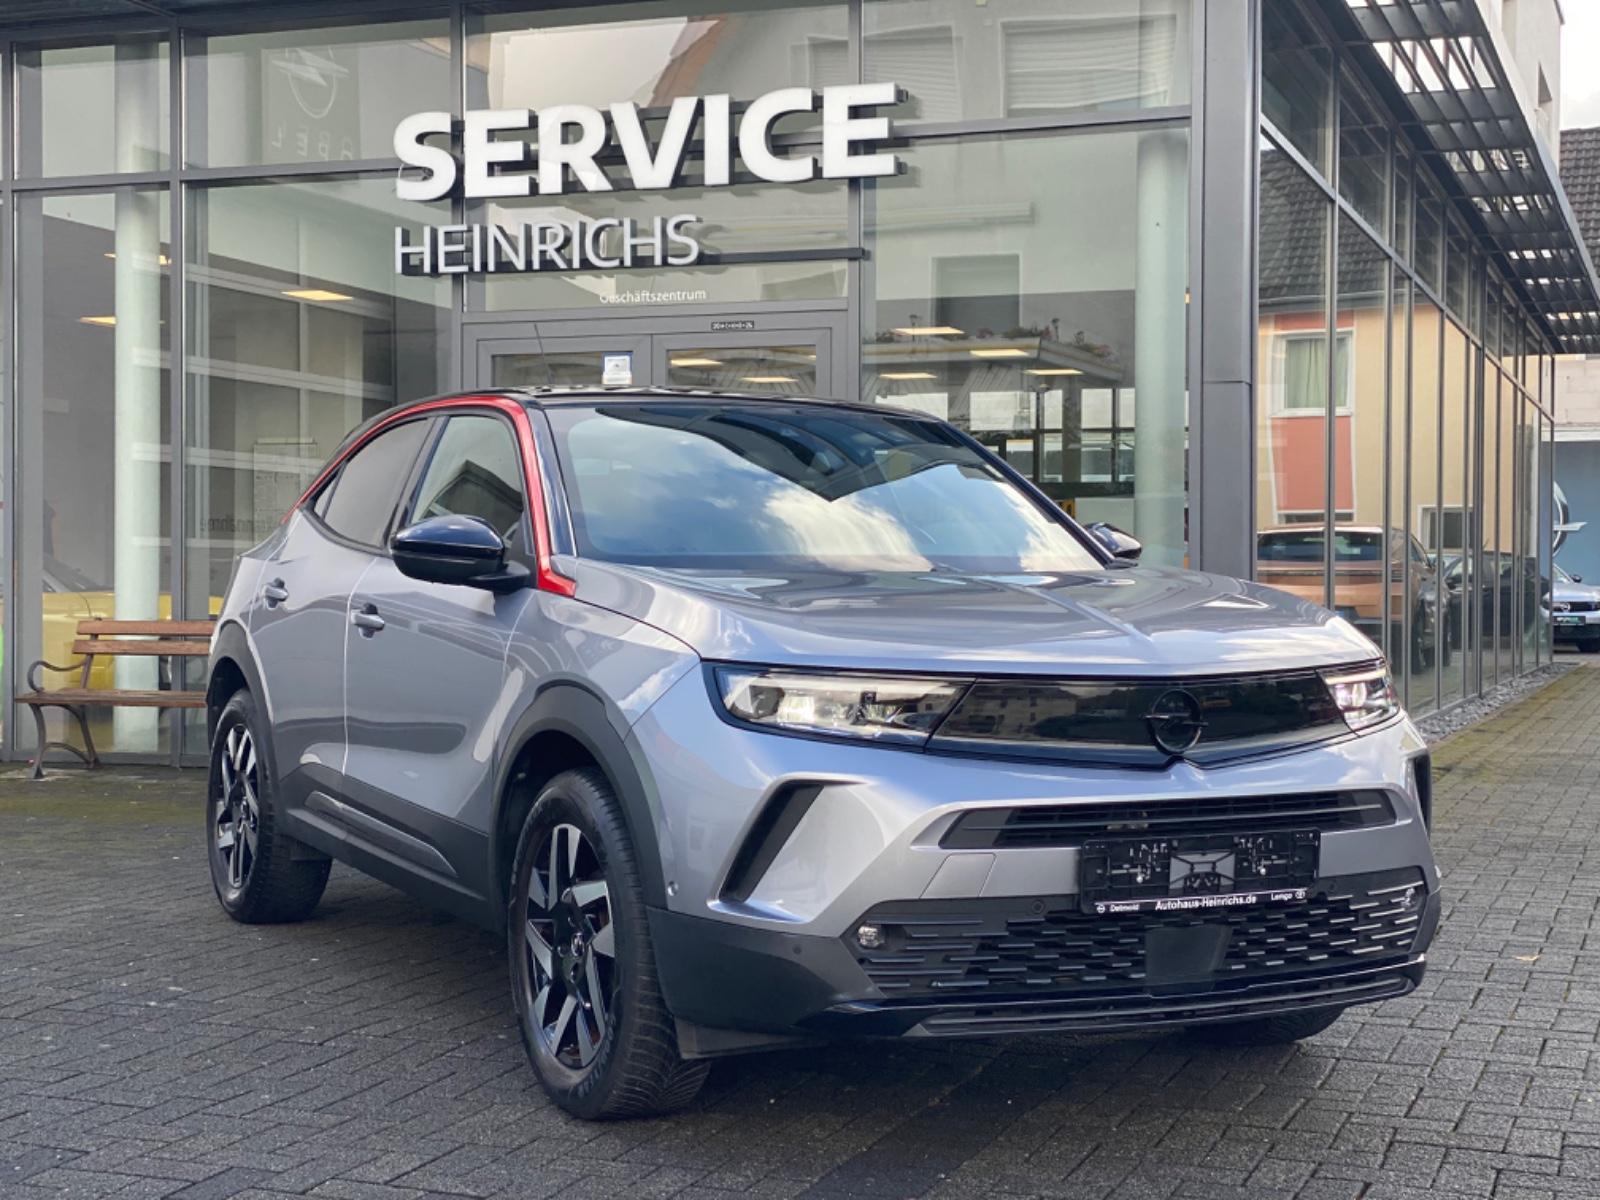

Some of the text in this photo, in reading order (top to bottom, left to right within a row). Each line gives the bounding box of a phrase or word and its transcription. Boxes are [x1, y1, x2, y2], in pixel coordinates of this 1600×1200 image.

[393, 82, 899, 202] SERVICE
[394, 214, 702, 275] HEINRICHS
[599, 288, 707, 304] Geschäftszentrum
[1154, 894, 1257, 911] Autohaus-Heinrichs.de
